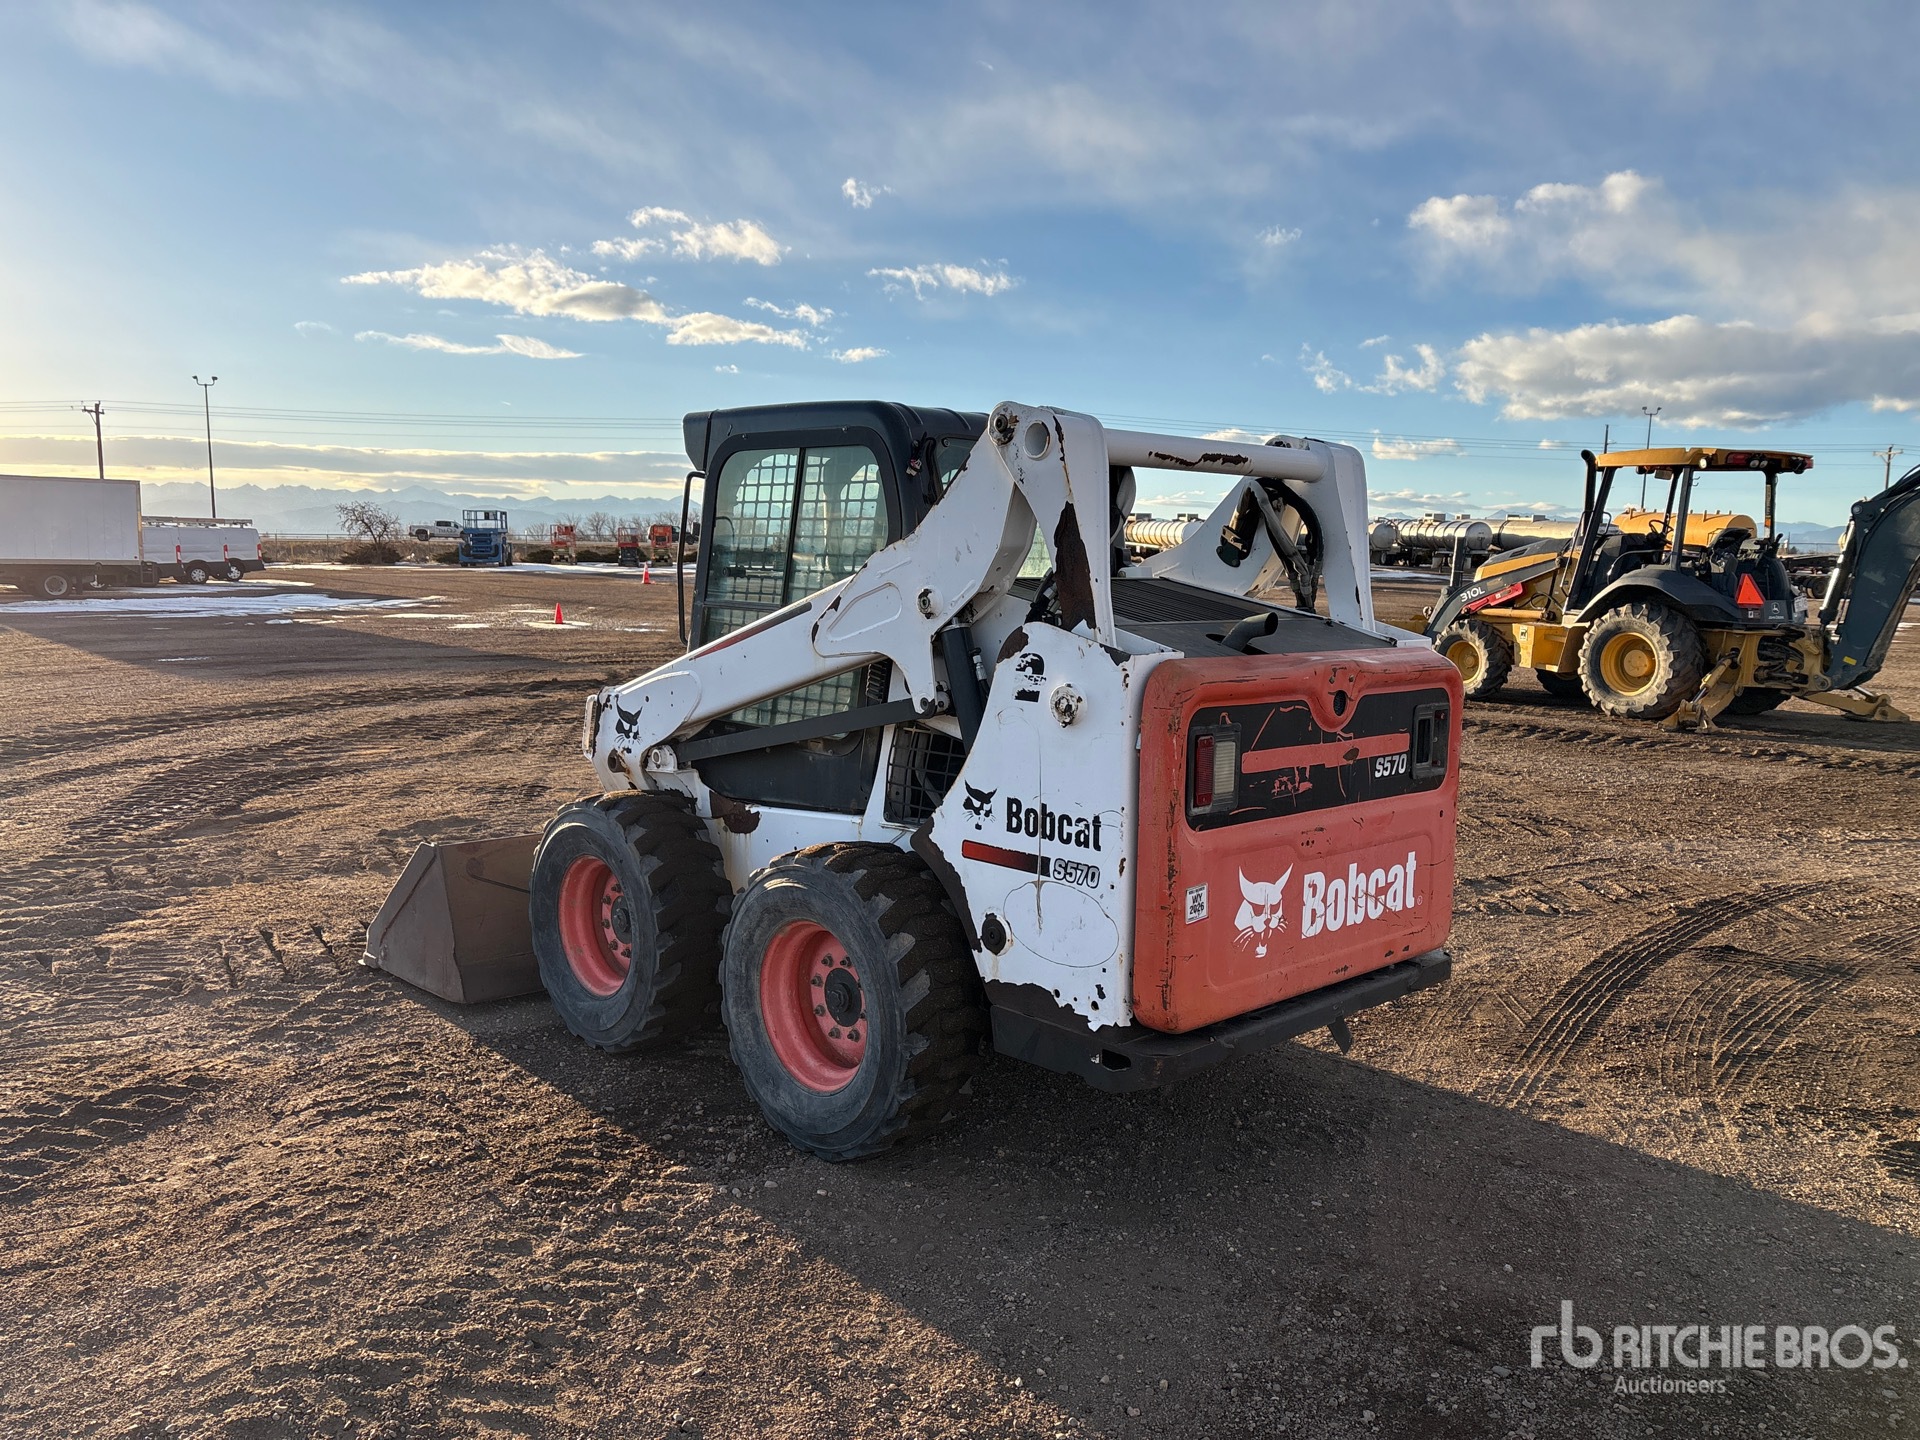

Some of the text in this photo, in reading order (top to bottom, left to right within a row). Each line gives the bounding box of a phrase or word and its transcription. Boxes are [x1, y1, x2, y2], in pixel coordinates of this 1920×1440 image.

[1460, 587, 1486, 602] 310L
[1374, 753, 1408, 778] S570
[1006, 796, 1102, 852] Bobcat
[1052, 857, 1101, 889] S570
[1191, 892, 1203, 904] WY
[1302, 850, 1417, 939] Bobcat
[1189, 901, 1205, 915] 2026
